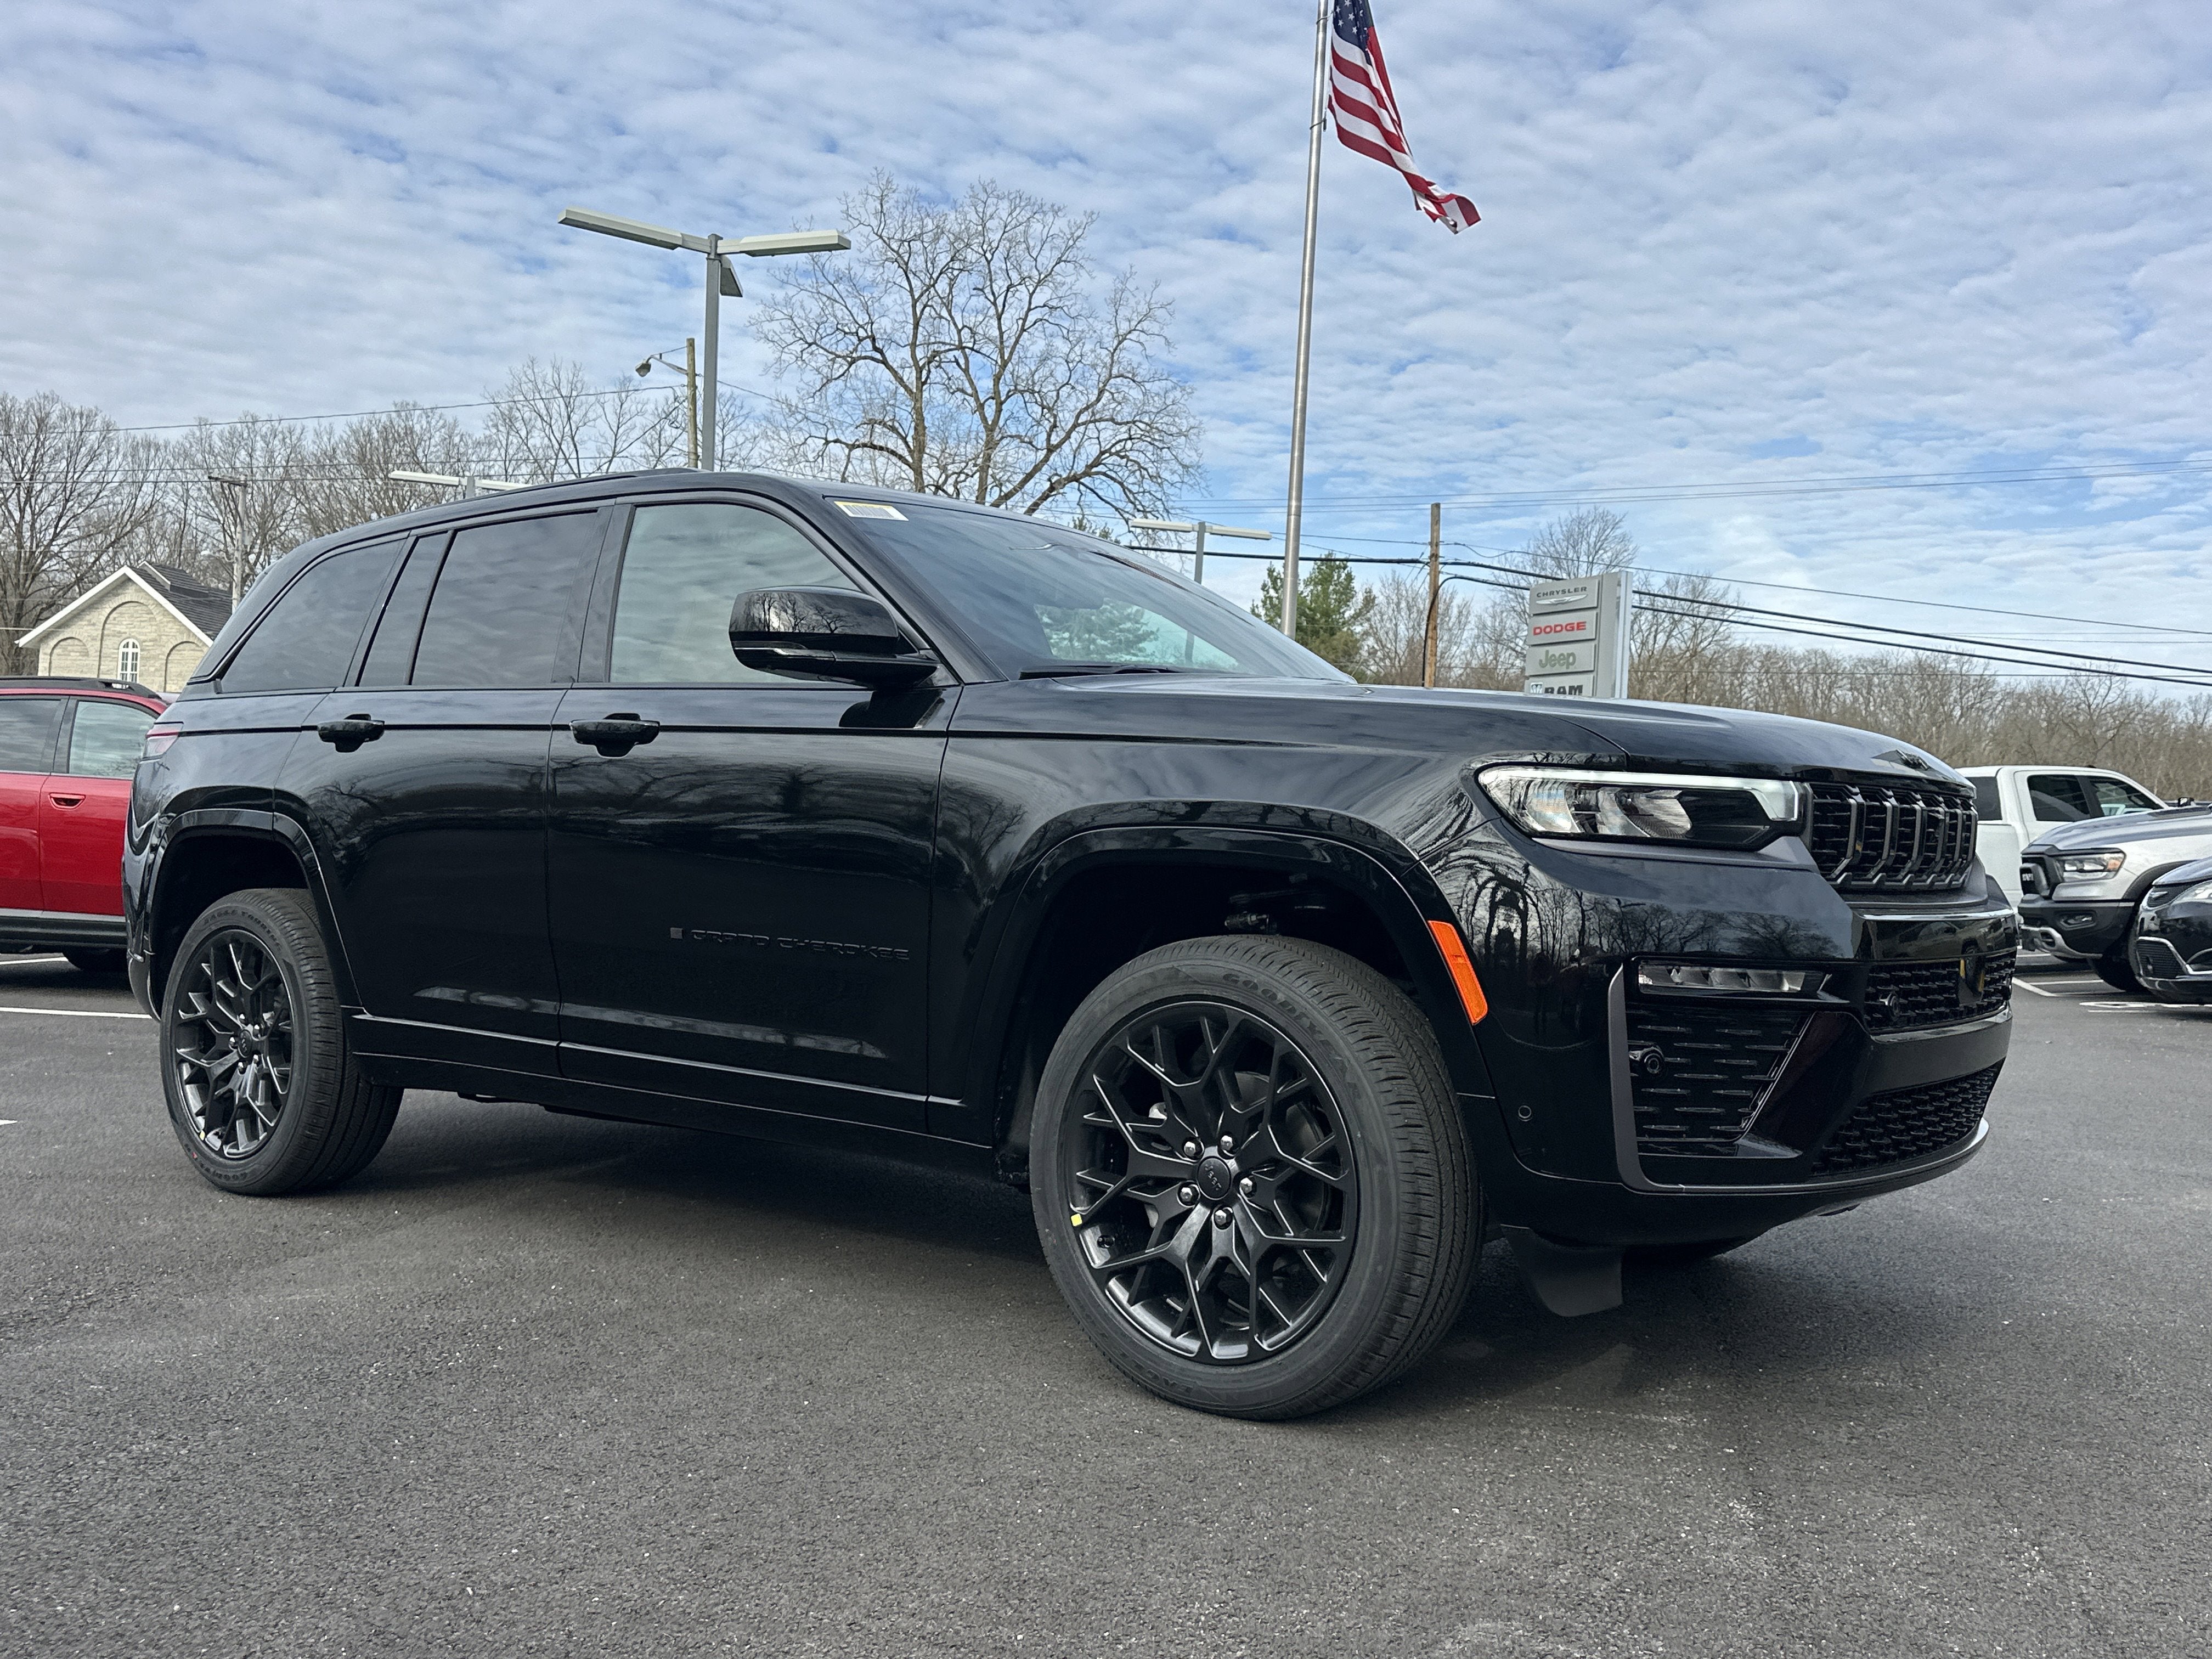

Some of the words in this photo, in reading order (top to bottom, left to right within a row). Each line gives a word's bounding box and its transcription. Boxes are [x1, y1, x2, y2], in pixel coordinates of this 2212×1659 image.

[1536, 586, 1587, 598] CHRYSLER
[1533, 621, 1587, 636] DODGE
[1538, 649, 1577, 670] Jeep
[1544, 685, 1583, 696] RAM
[1222, 973, 1363, 1101] GOODYEAR
